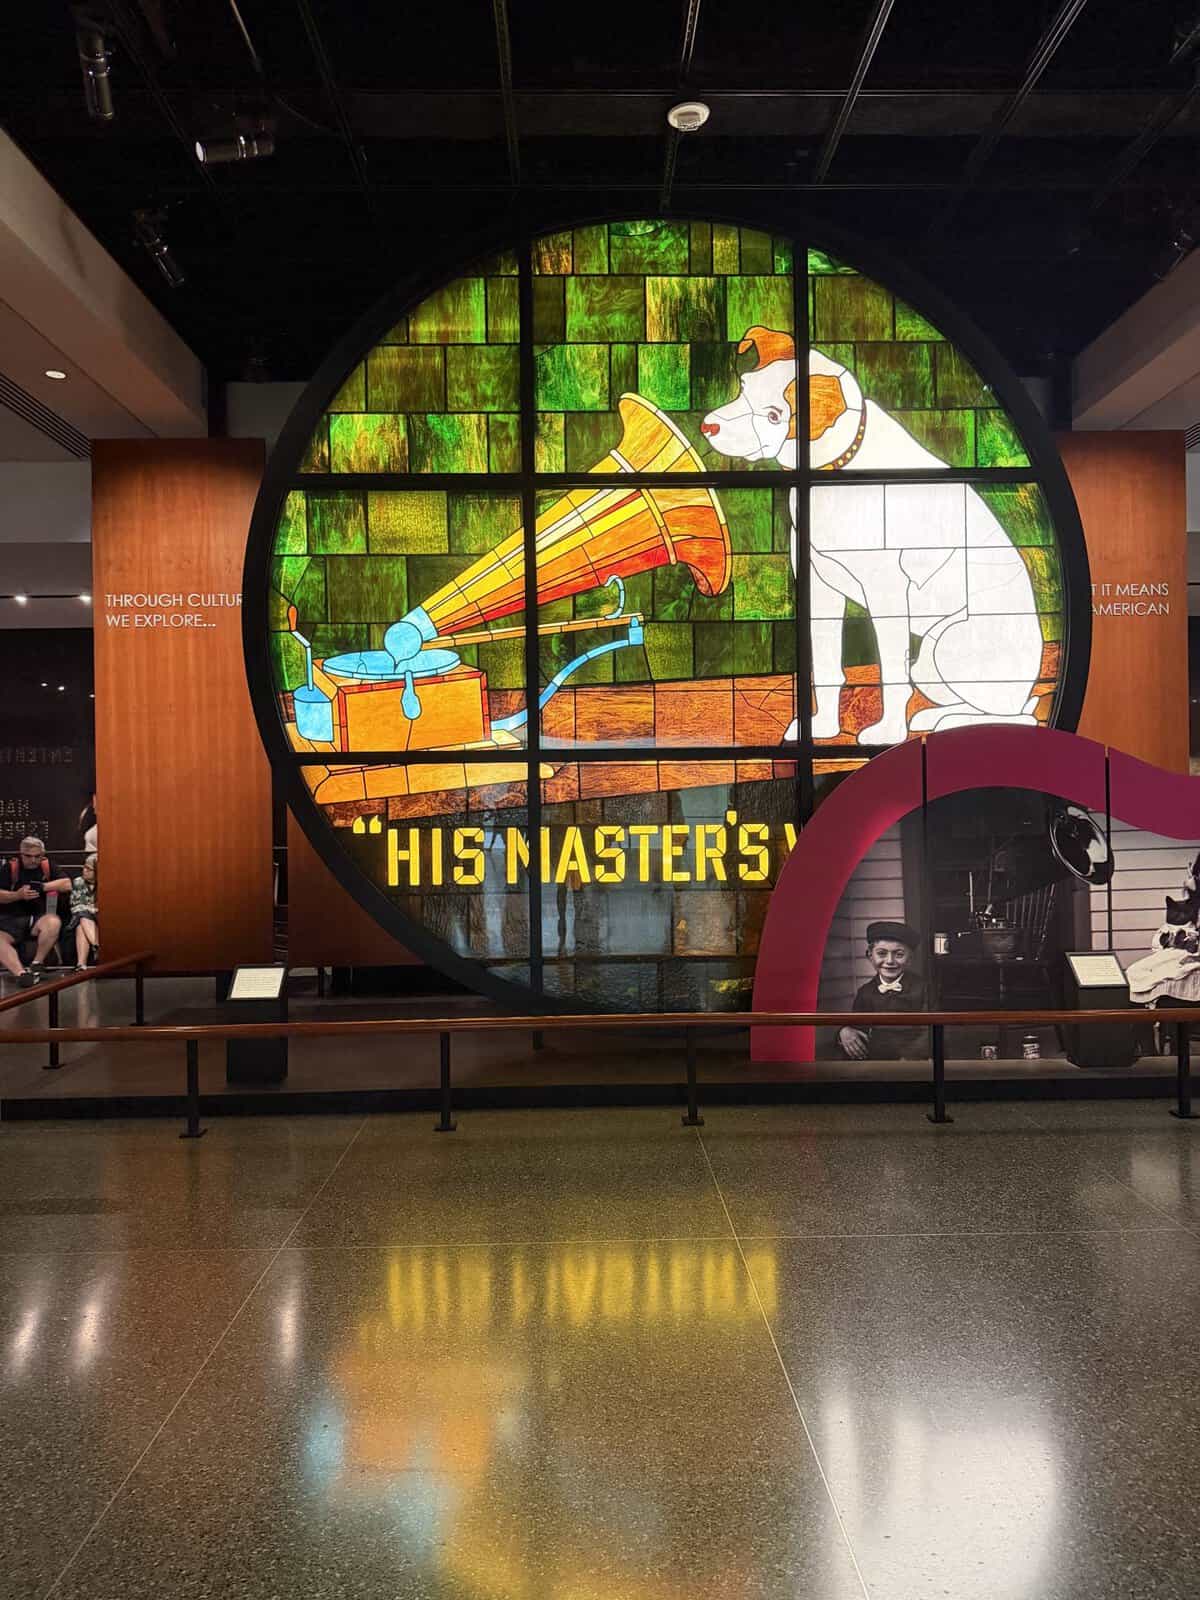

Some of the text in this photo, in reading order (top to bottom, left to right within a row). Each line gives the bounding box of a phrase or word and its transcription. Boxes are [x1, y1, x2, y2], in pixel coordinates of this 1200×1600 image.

[1102, 583, 1112, 596] IT
[1116, 583, 1169, 596] MEANS
[105, 593, 182, 607] THROUGH
[106, 614, 216, 627] WE EXPLORE...
